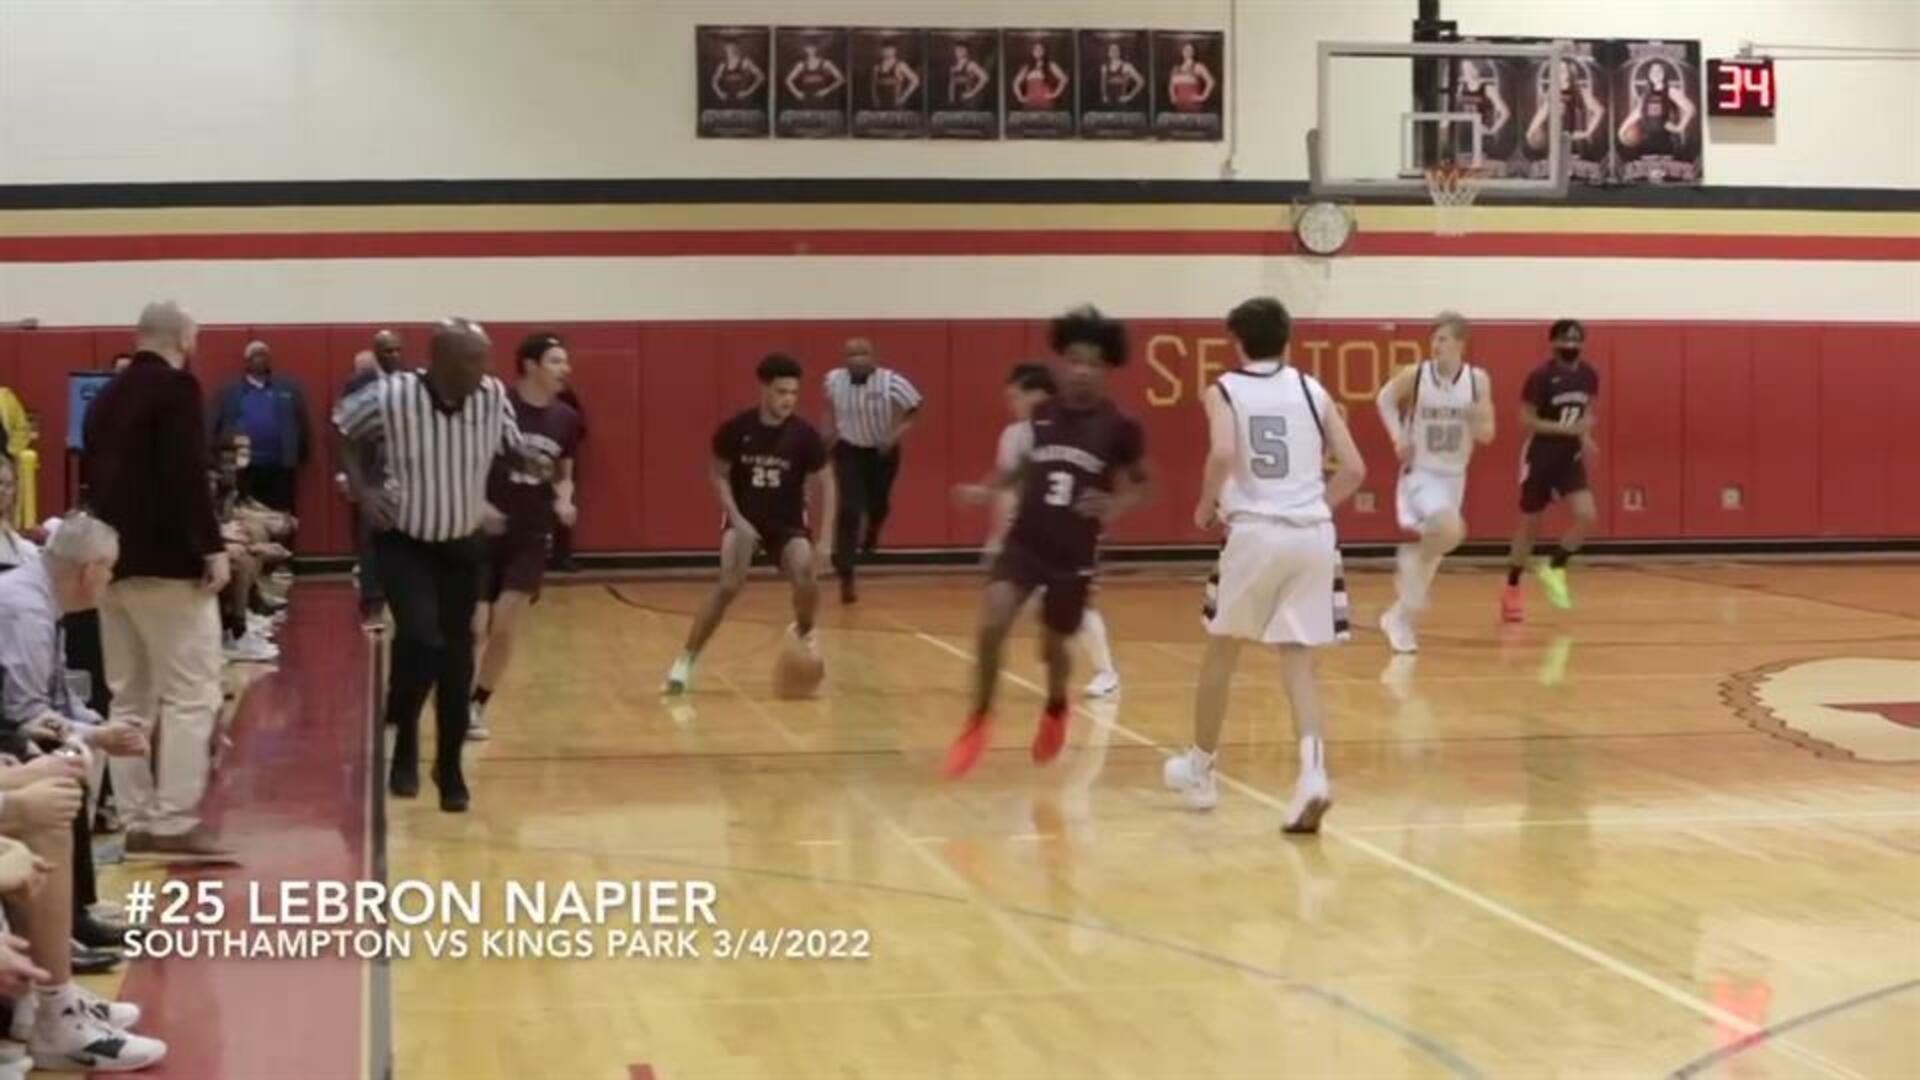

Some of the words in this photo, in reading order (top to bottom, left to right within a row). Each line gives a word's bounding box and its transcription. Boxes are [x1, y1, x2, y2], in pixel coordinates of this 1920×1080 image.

[1719, 65, 1769, 109] 34
[1249, 415, 1289, 480] 5
[752, 466, 781, 488] 25
[1044, 471, 1075, 507] 3
